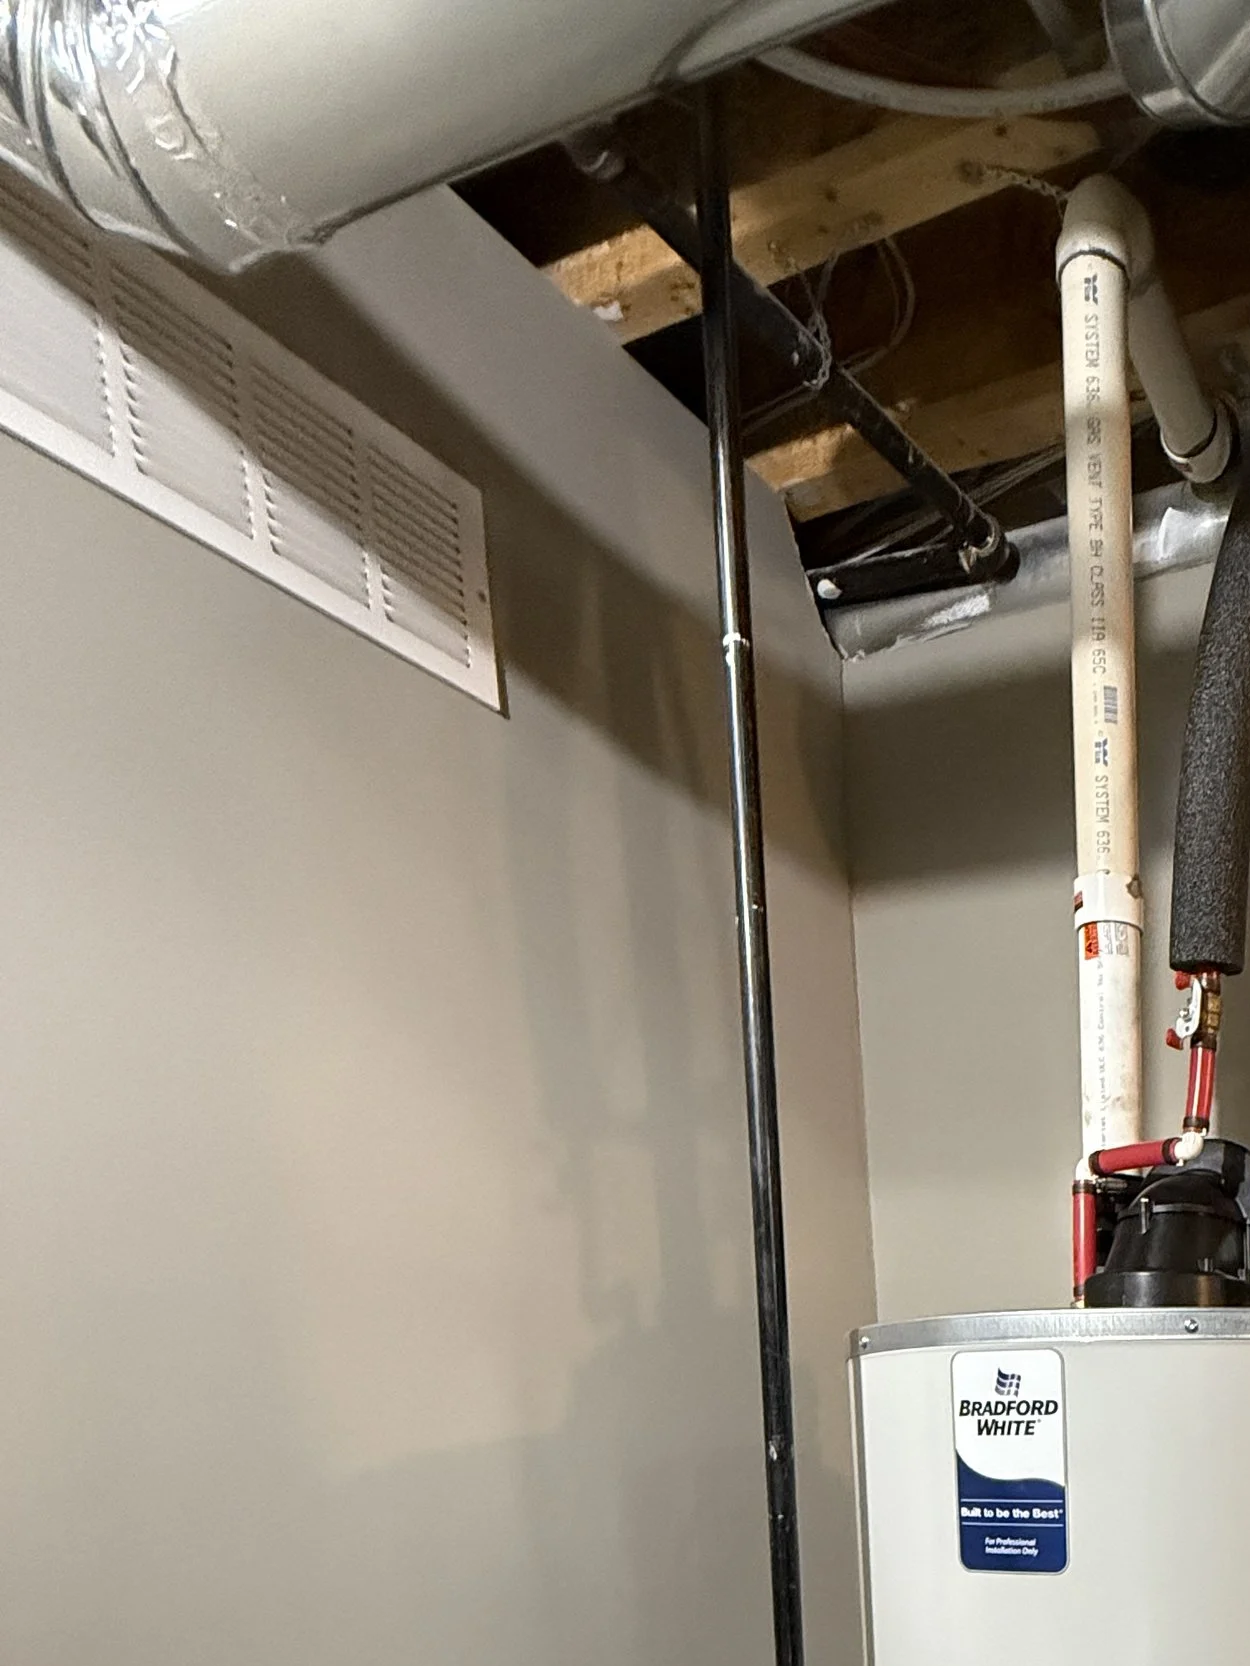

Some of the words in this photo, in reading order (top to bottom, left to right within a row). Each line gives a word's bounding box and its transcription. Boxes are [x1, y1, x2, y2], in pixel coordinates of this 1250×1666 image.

[1089, 497, 1103, 531] TYPE
[1090, 565, 1105, 608] CLASS
[1095, 775, 1110, 823] SYSTEM
[1096, 830, 1111, 854] 636
[959, 1400, 1058, 1416] BRADFORD
[960, 1507, 982, 1518] Built
[983, 1508, 994, 1518] to
[996, 1508, 1010, 1518] be
[1012, 1508, 1030, 1519] the
[985, 1537, 995, 1545] For
[996, 1537, 1036, 1546] Professional
[985, 1546, 1021, 1555] Installation
[1022, 1547, 1039, 1557] Only
